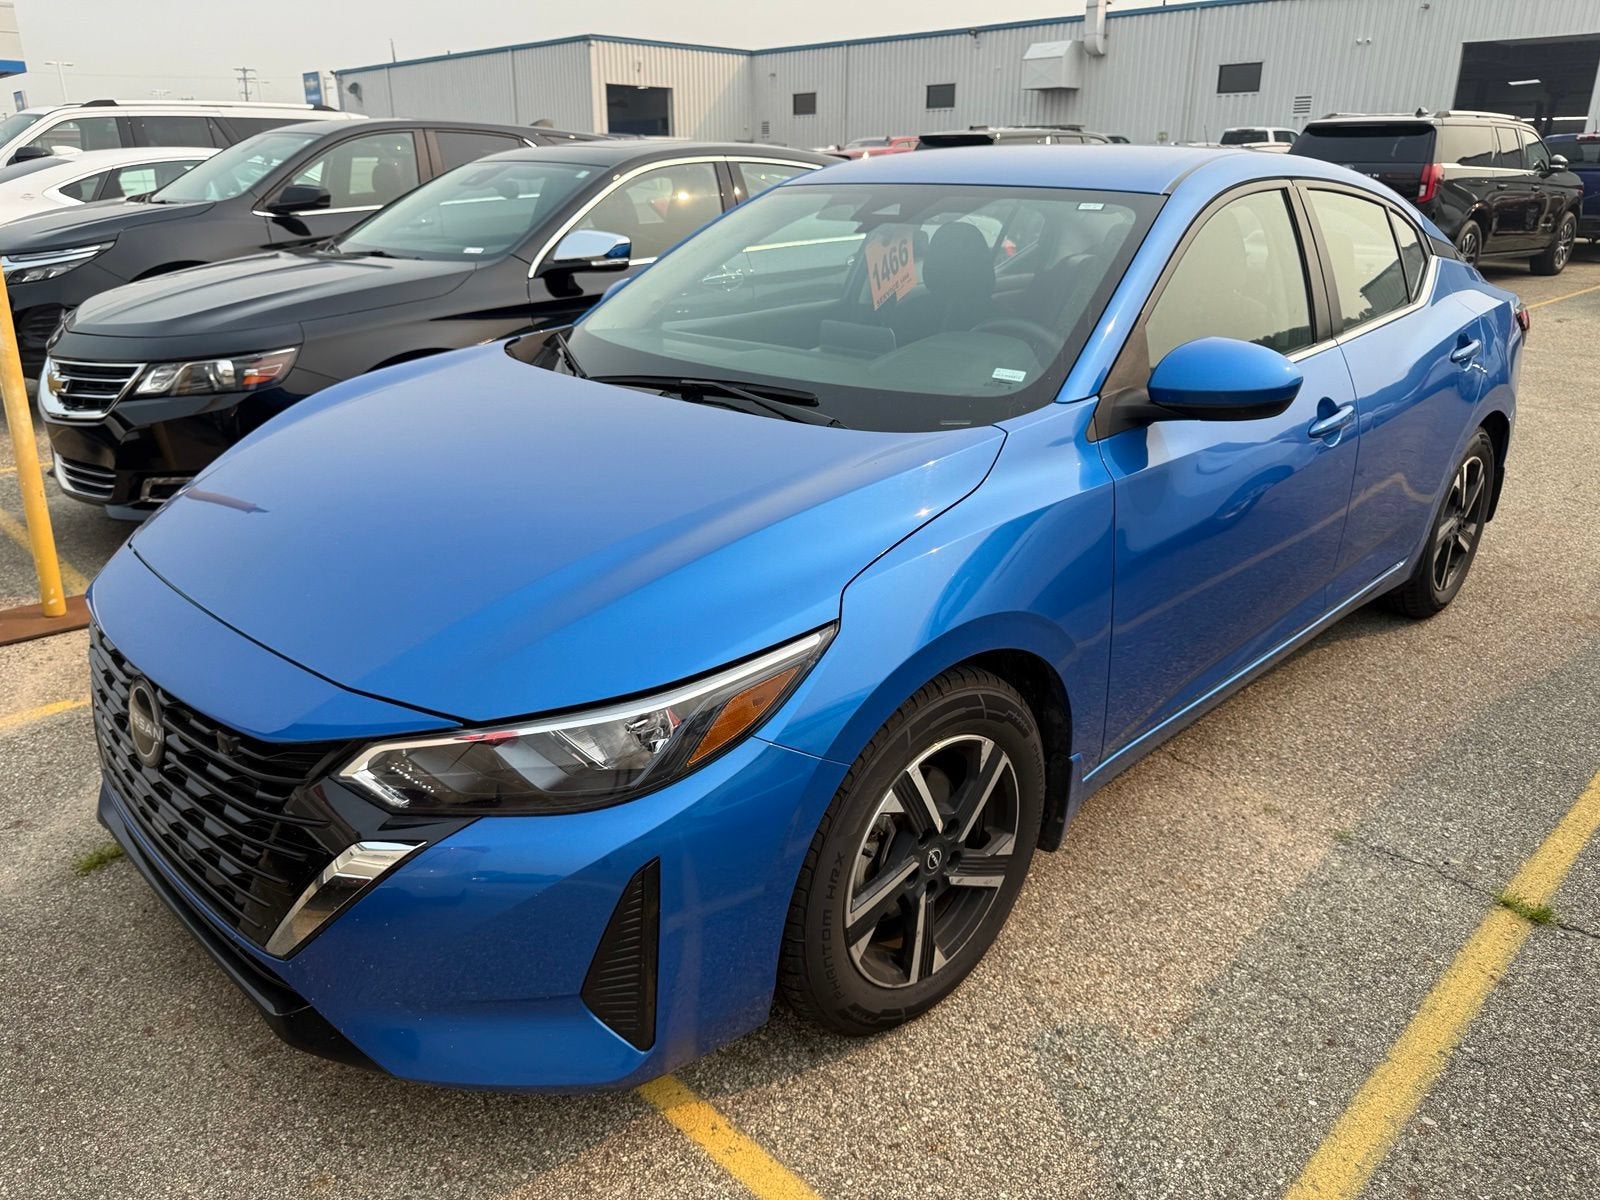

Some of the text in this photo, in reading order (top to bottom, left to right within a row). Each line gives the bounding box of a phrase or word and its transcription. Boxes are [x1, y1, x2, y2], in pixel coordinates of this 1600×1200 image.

[873, 239, 908, 290] 1466
[821, 851, 846, 999] PHANTOM HRX
